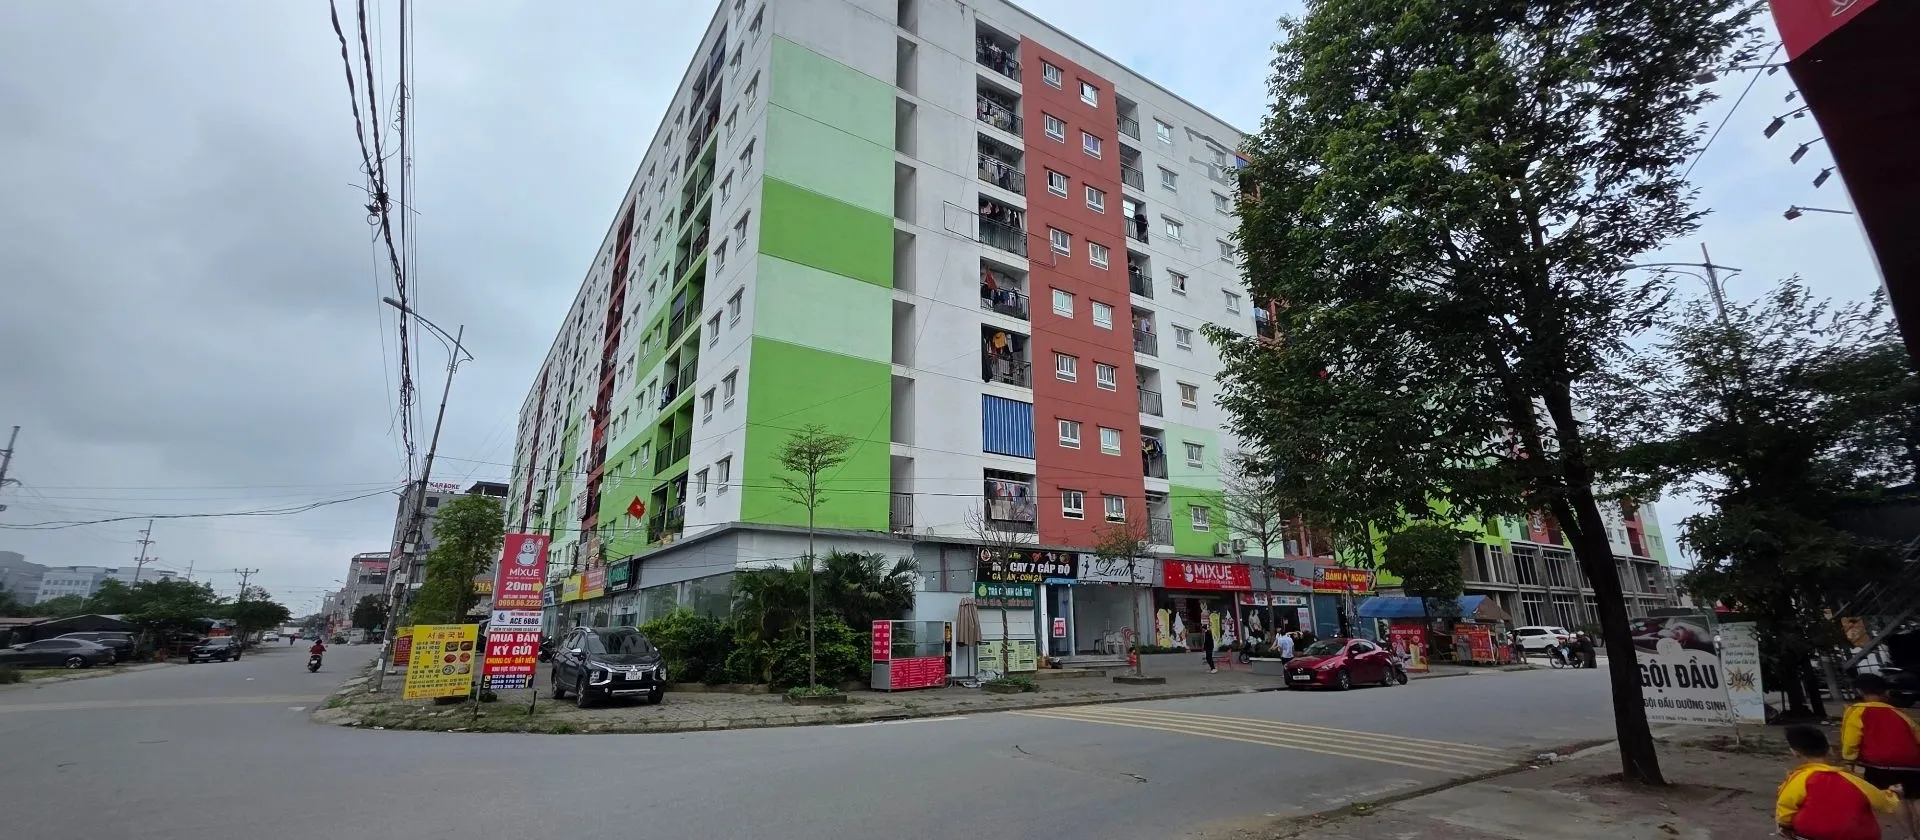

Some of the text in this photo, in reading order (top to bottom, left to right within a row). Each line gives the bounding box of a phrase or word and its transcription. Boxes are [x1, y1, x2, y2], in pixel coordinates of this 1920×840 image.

[1010, 562, 1029, 572] CAY
[1030, 563, 1035, 573] 7
[1194, 563, 1233, 580] MIXUE
[490, 632, 539, 643] MUA BÁN
[492, 643, 508, 656] KÝ
[1640, 656, 1719, 693] GỘI ĐẦU
[1705, 700, 1727, 711] SINH
